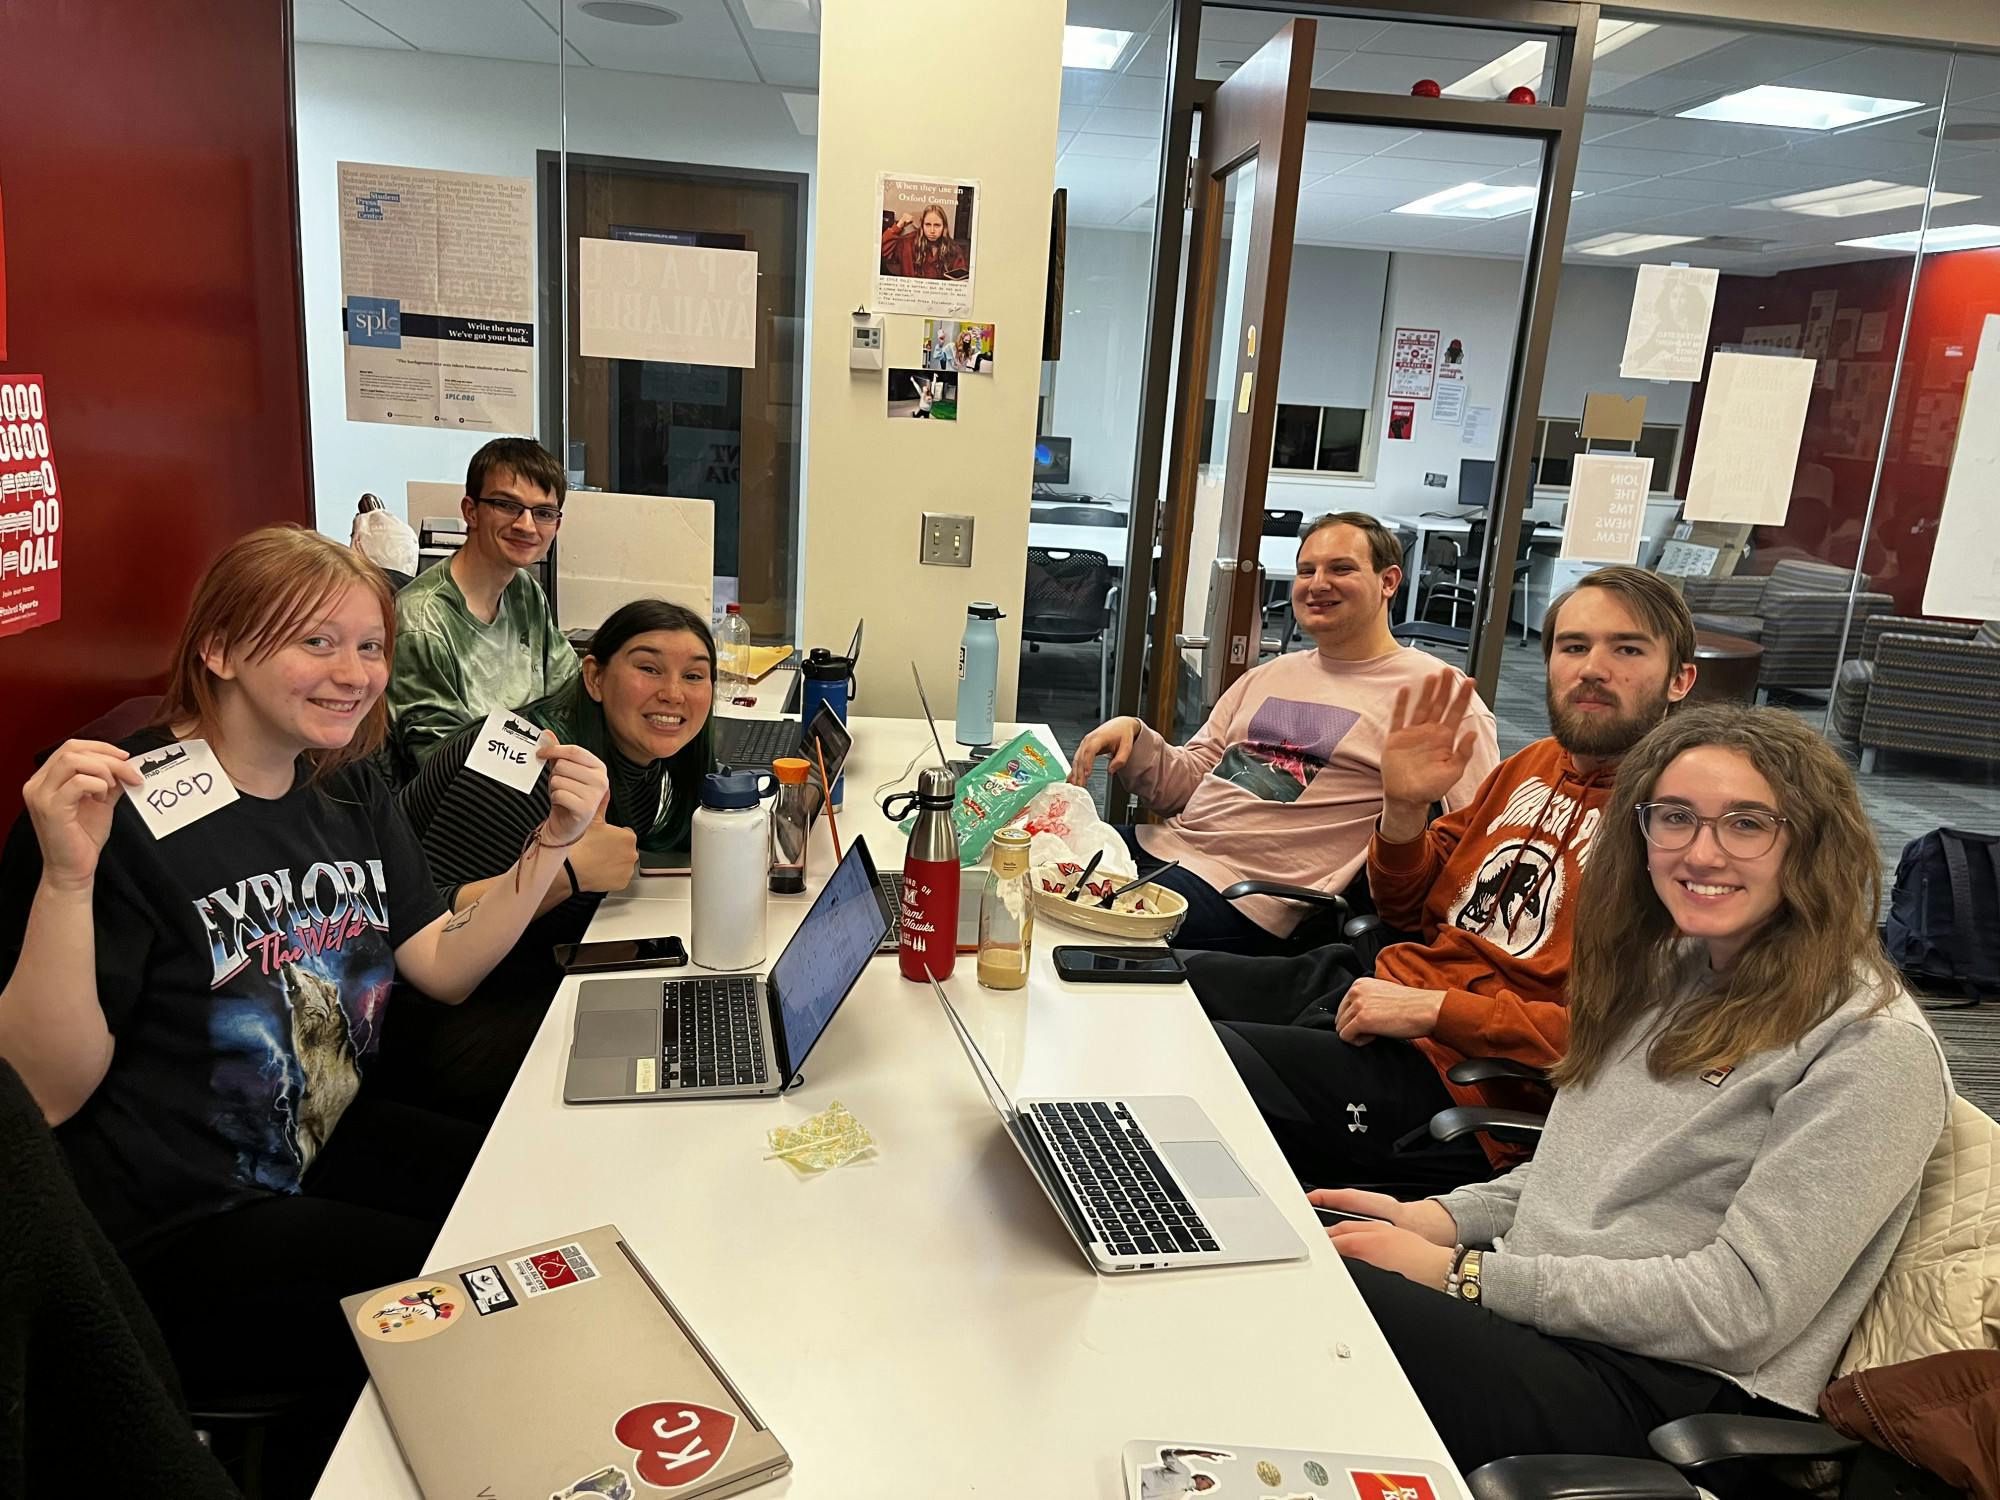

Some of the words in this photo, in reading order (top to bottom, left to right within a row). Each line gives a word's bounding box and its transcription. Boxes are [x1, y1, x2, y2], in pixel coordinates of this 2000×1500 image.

[895, 181, 918, 191] When
[920, 184, 936, 194] they
[371, 193, 399, 201] Student
[898, 193, 926, 203] Oxford
[928, 195, 959, 206] Comma
[356, 308, 398, 336] splc
[467, 322, 490, 331] Write
[491, 324, 505, 332] the
[506, 326, 529, 335] story.
[448, 330, 473, 338] We've
[507, 335, 529, 343] back.
[0, 384, 43, 422] OOO
[488, 739, 527, 764] STYLE
[144, 769, 160, 780] map
[146, 772, 213, 815] FOOD
[921, 885, 932, 896] OH
[247, 930, 303, 975] The
[297, 906, 369, 958] Wild
[652, 1409, 711, 1471] KC
